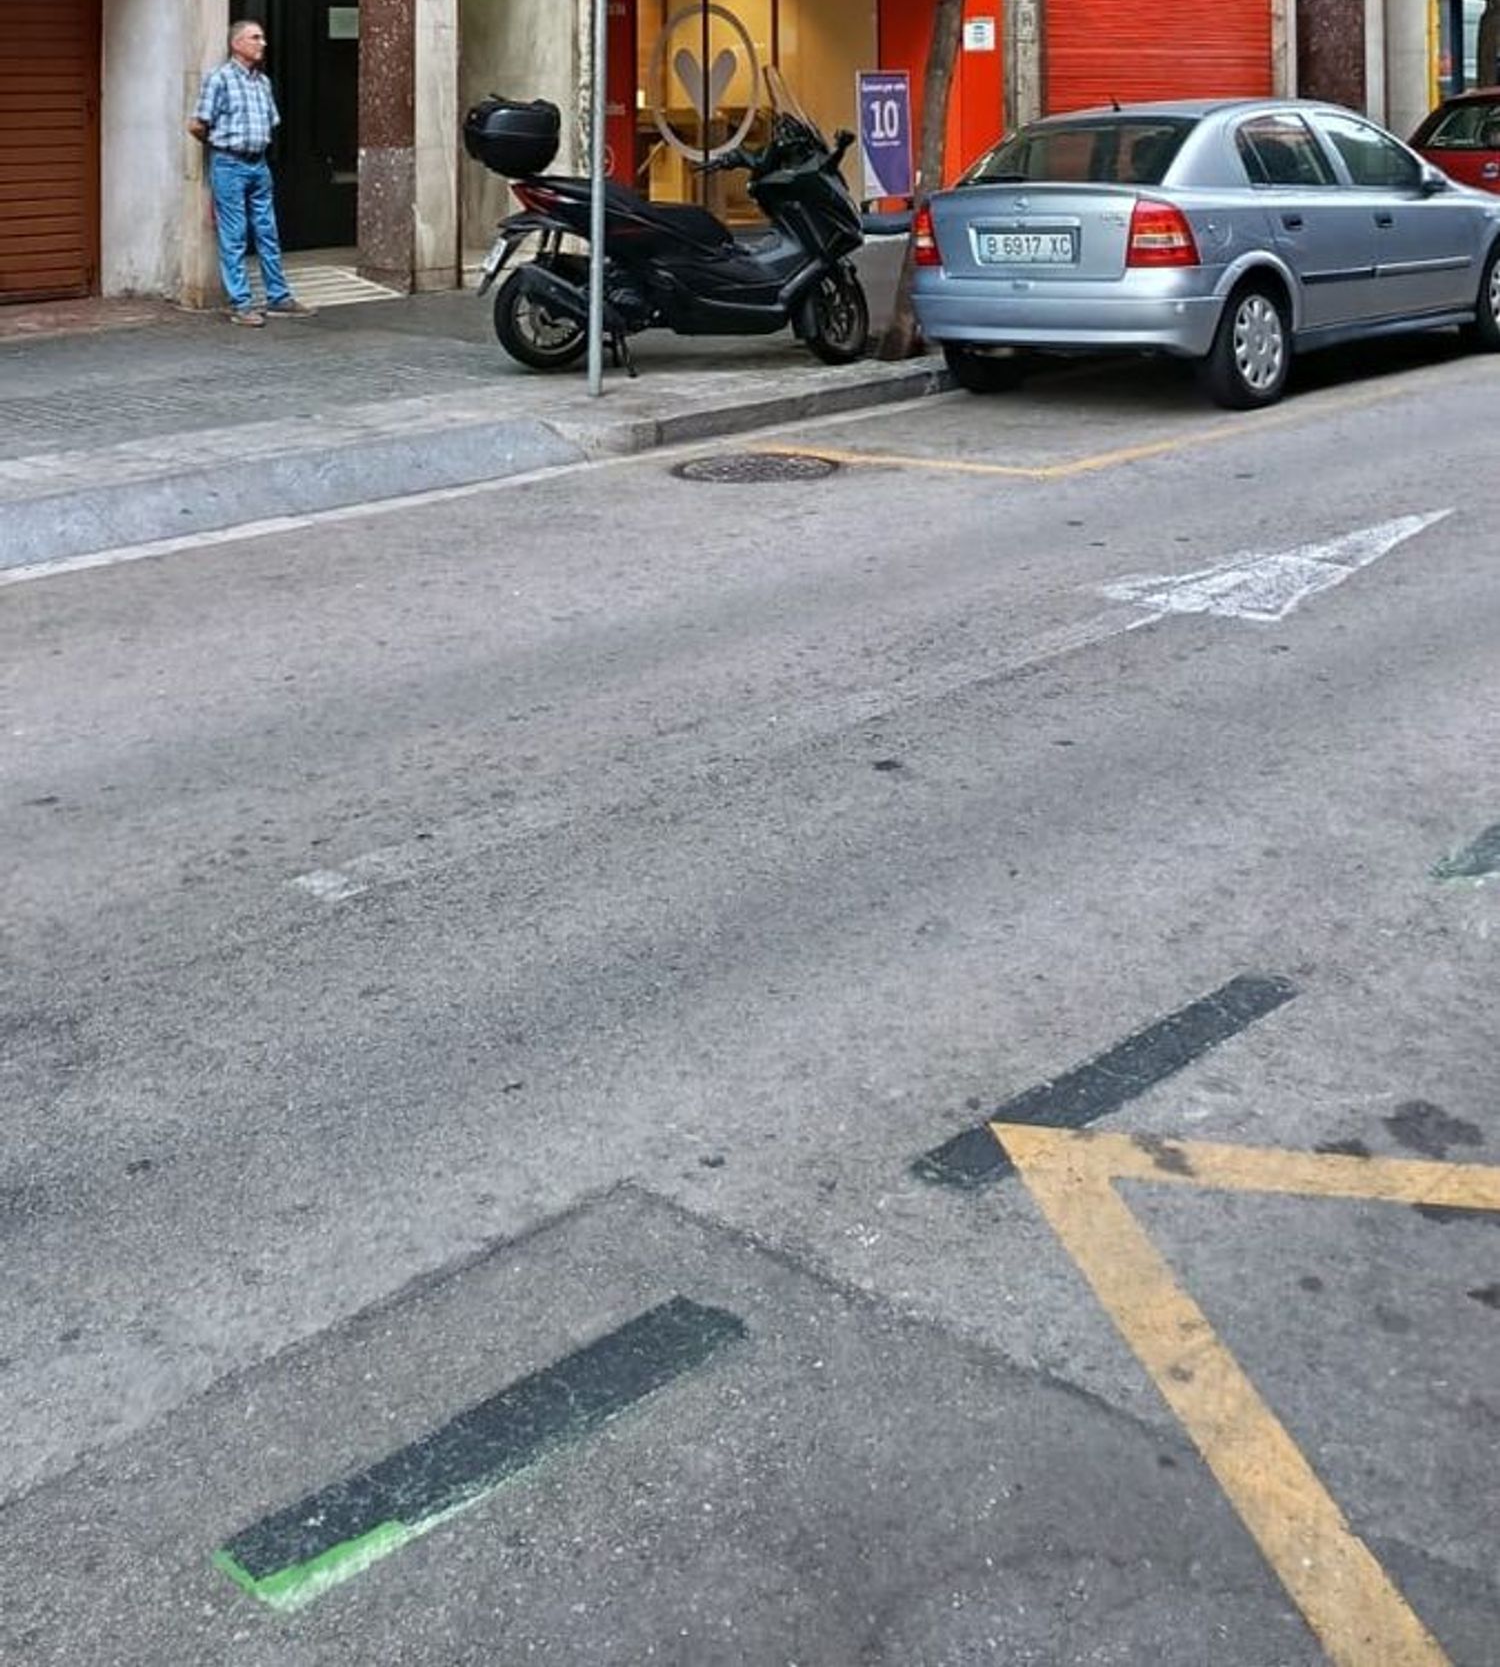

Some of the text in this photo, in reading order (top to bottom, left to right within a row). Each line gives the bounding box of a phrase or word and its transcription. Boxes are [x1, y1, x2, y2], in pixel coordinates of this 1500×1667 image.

[870, 99, 899, 140] 10
[987, 236, 1071, 256] B 6917 XC
